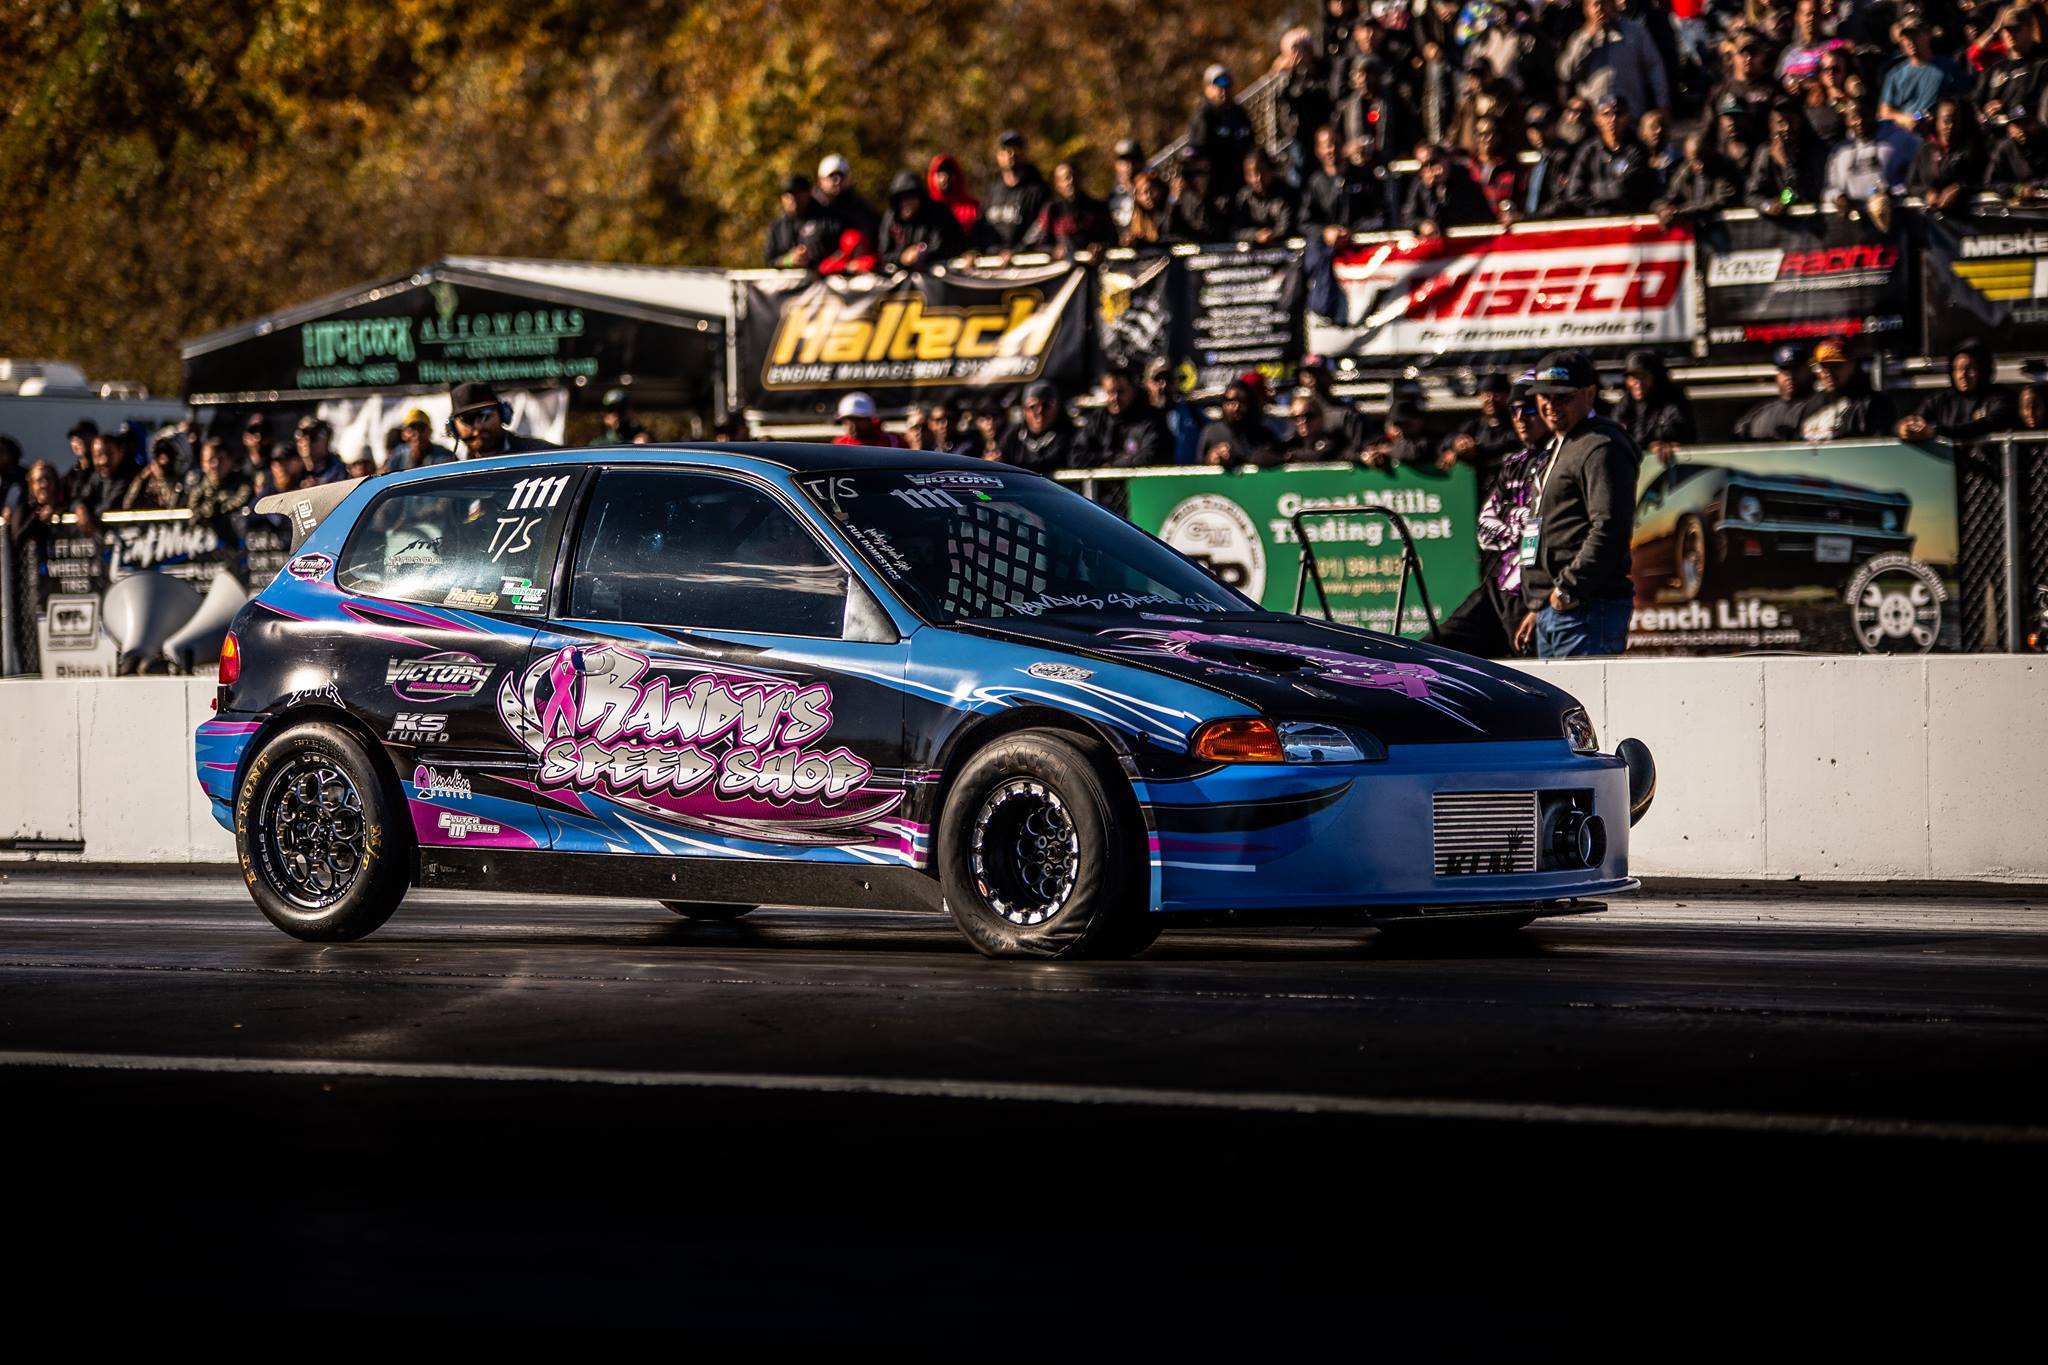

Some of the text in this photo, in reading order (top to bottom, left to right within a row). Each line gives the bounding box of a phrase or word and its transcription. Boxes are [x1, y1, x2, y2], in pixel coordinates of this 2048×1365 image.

[1961, 236, 2048, 257] MICKE
[773, 296, 1048, 365] Haltech
[1419, 319, 1656, 345] Performance Products
[768, 364, 832, 384] ENGINE
[506, 475, 570, 510] 1111
[904, 473, 1005, 489] VICTORY
[889, 488, 964, 509] 1111
[1363, 489, 1442, 514] Mills
[487, 515, 543, 563] T/S
[860, 539, 902, 581] DOMESTICS
[446, 588, 498, 604] Haltech
[1629, 598, 1779, 631] rench Life
[1626, 629, 1801, 649] ywrenchclothing.com
[385, 657, 497, 692] VICTORY
[393, 713, 449, 732] KS
[387, 730, 451, 744] TUNED
[542, 742, 873, 798] SPEED SHOP
[238, 752, 270, 833] FRONT
[448, 823, 500, 838] MASTERS
